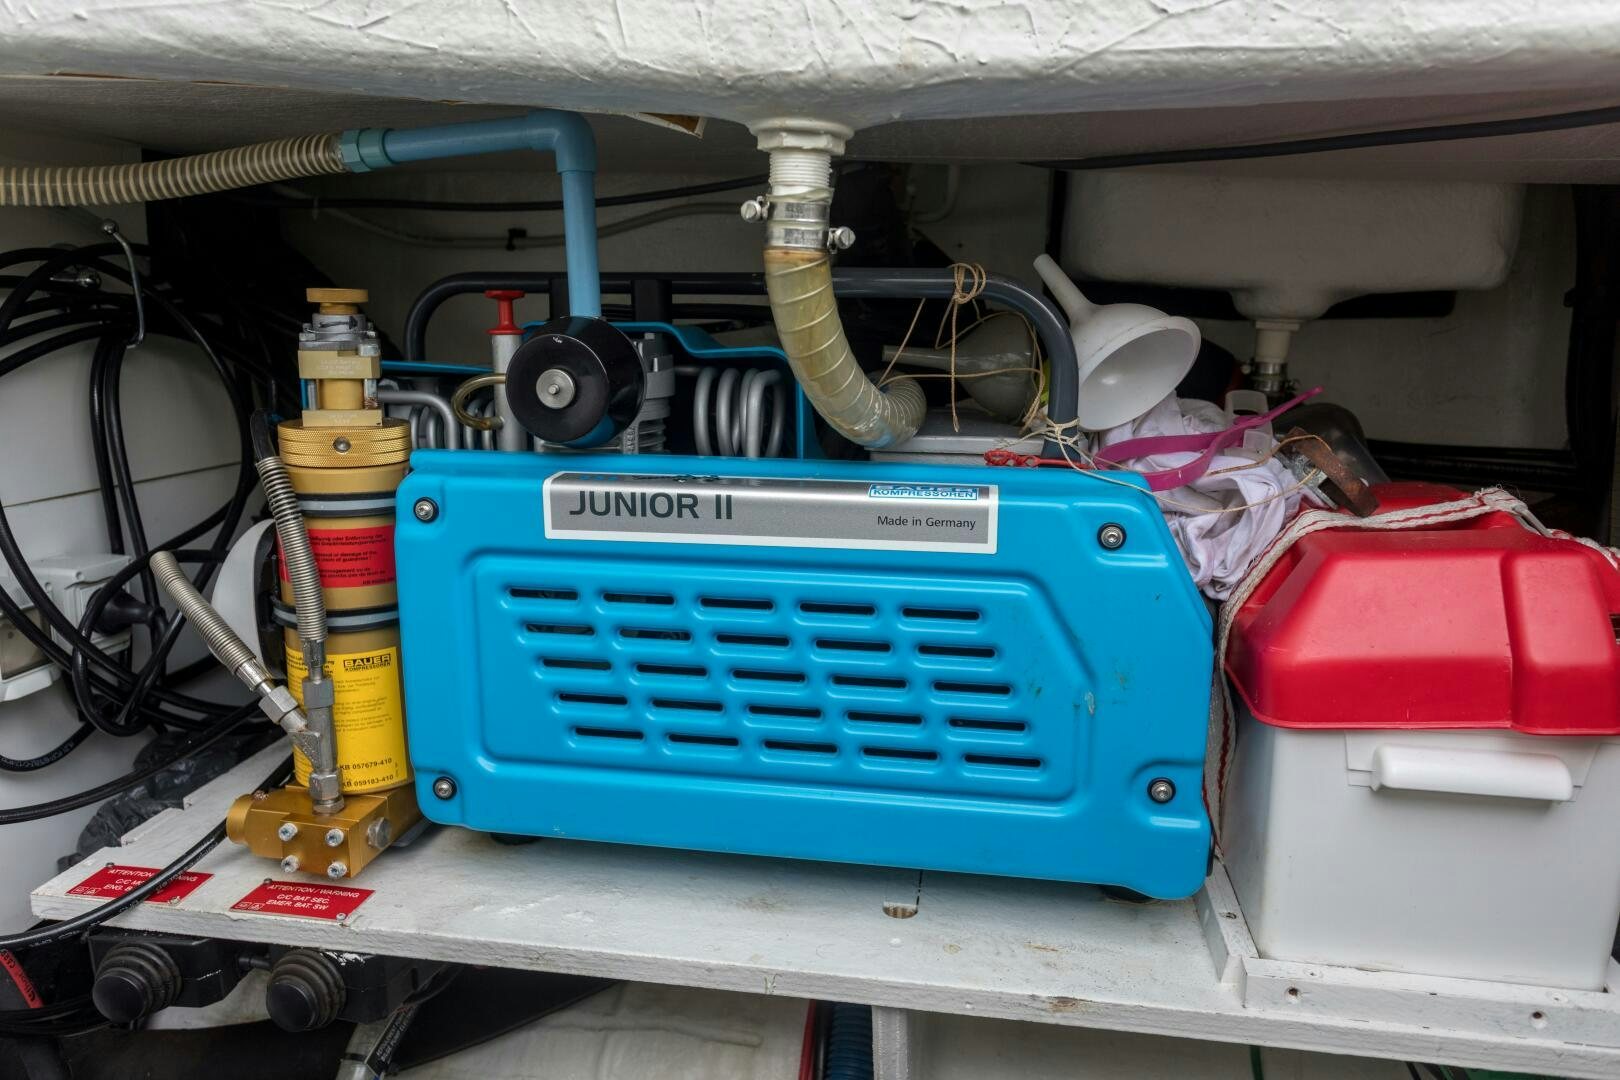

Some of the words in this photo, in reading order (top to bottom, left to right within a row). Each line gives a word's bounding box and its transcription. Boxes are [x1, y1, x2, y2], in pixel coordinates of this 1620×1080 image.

[873, 488, 974, 499] KOMPRESSOREN
[569, 490, 700, 519] JUNIOR
[715, 494, 733, 520] II
[877, 515, 909, 526] Made
[912, 516, 922, 526] in
[925, 517, 976, 530] Germany
[344, 653, 391, 667] BAUER
[352, 757, 393, 770] 057679-410
[108, 868, 155, 878] ATTENTION
[267, 884, 315, 893] ATTENTION
[319, 889, 360, 898] WARNING
[312, 903, 329, 911] SW
